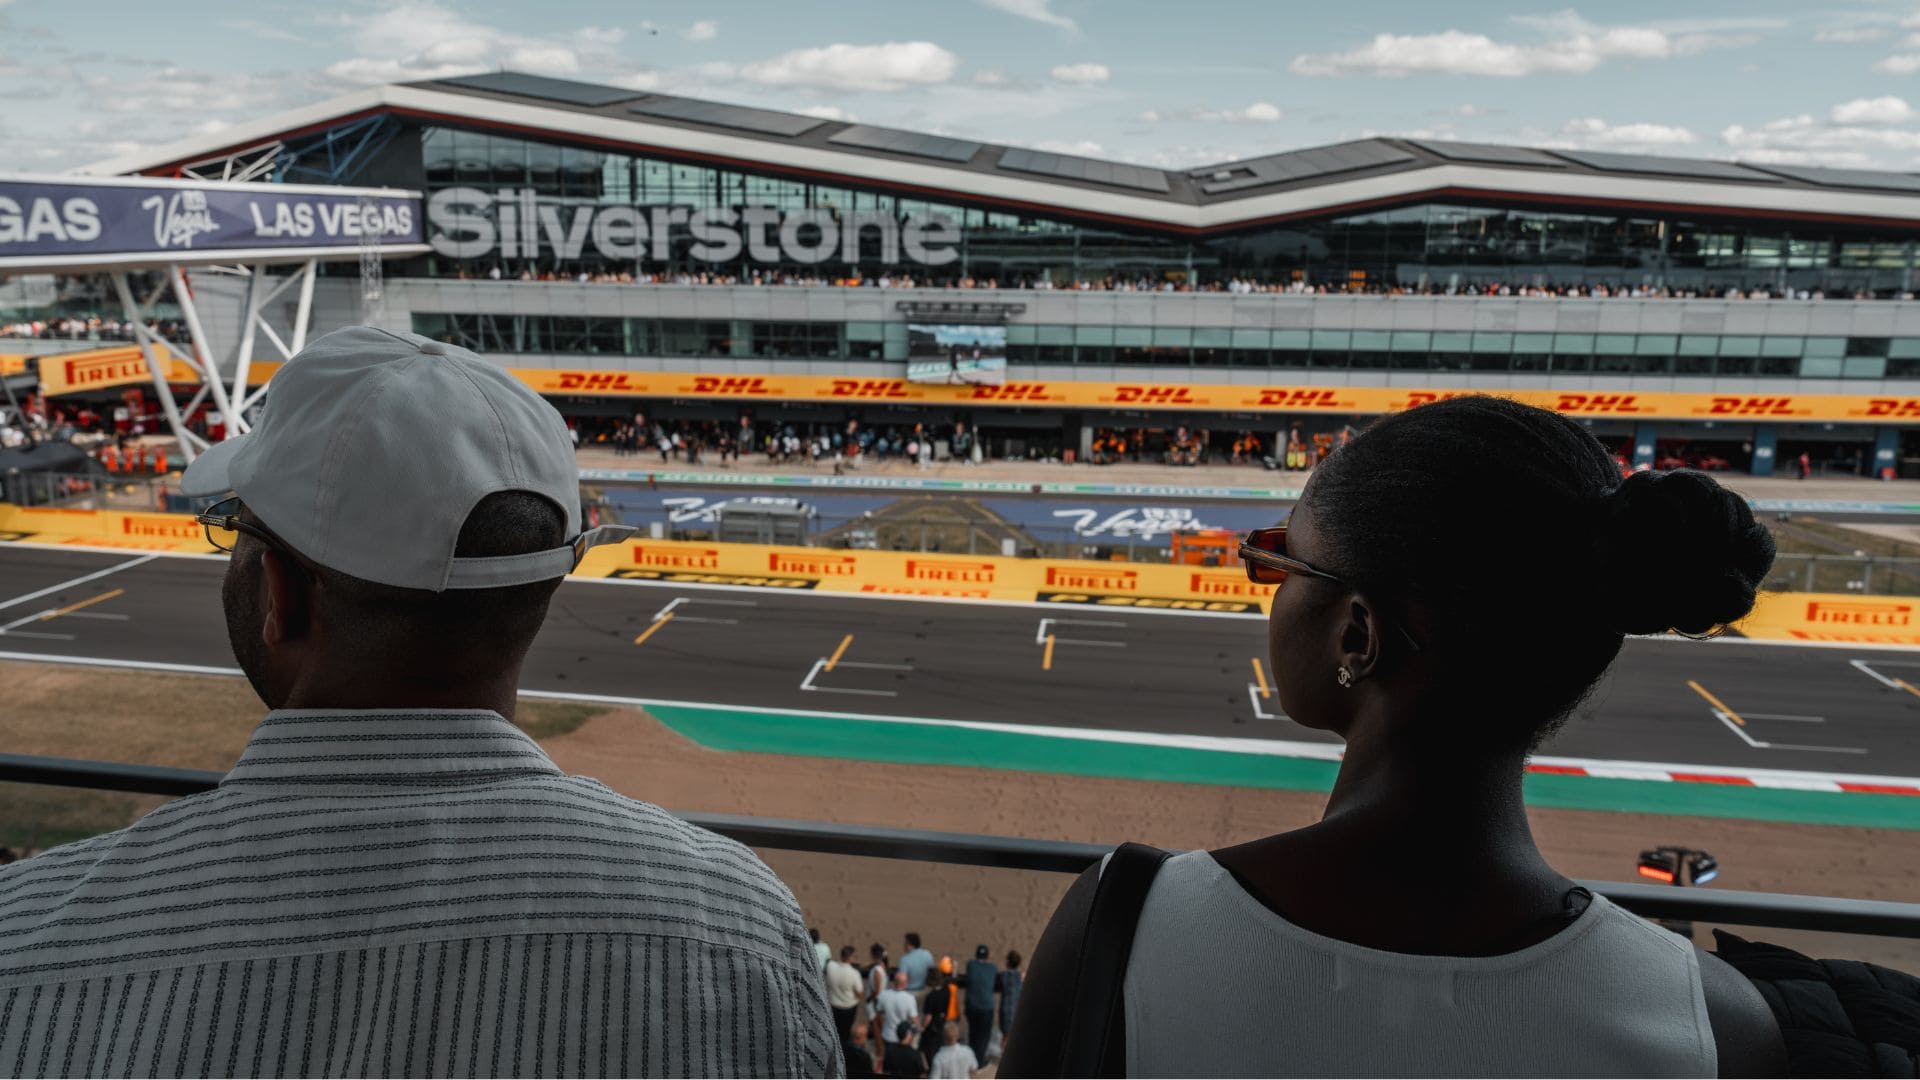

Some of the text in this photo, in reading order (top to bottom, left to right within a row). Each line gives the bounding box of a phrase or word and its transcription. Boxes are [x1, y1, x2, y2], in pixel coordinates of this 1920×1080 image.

[251, 202, 413, 237] LAS VEGAS
[428, 187, 962, 266] Silverstone
[560, 374, 633, 390] DHL
[695, 378, 769, 393] DHL
[833, 381, 908, 397] DHL
[971, 384, 1049, 400] DHL
[1115, 388, 1193, 403] DHL
[1259, 391, 1338, 407] DHL
[1557, 396, 1638, 412] DHL
[1711, 399, 1793, 415] DHL
[122, 516, 199, 538] PIRELLI
[633, 546, 718, 568] PIRELLI
[769, 553, 856, 576] PIRELLI
[905, 559, 995, 583] PIRELLI
[1045, 567, 1137, 590] PIRELLI
[1190, 573, 1273, 597] PIRELL
[1805, 601, 1912, 626] PIRELLI
